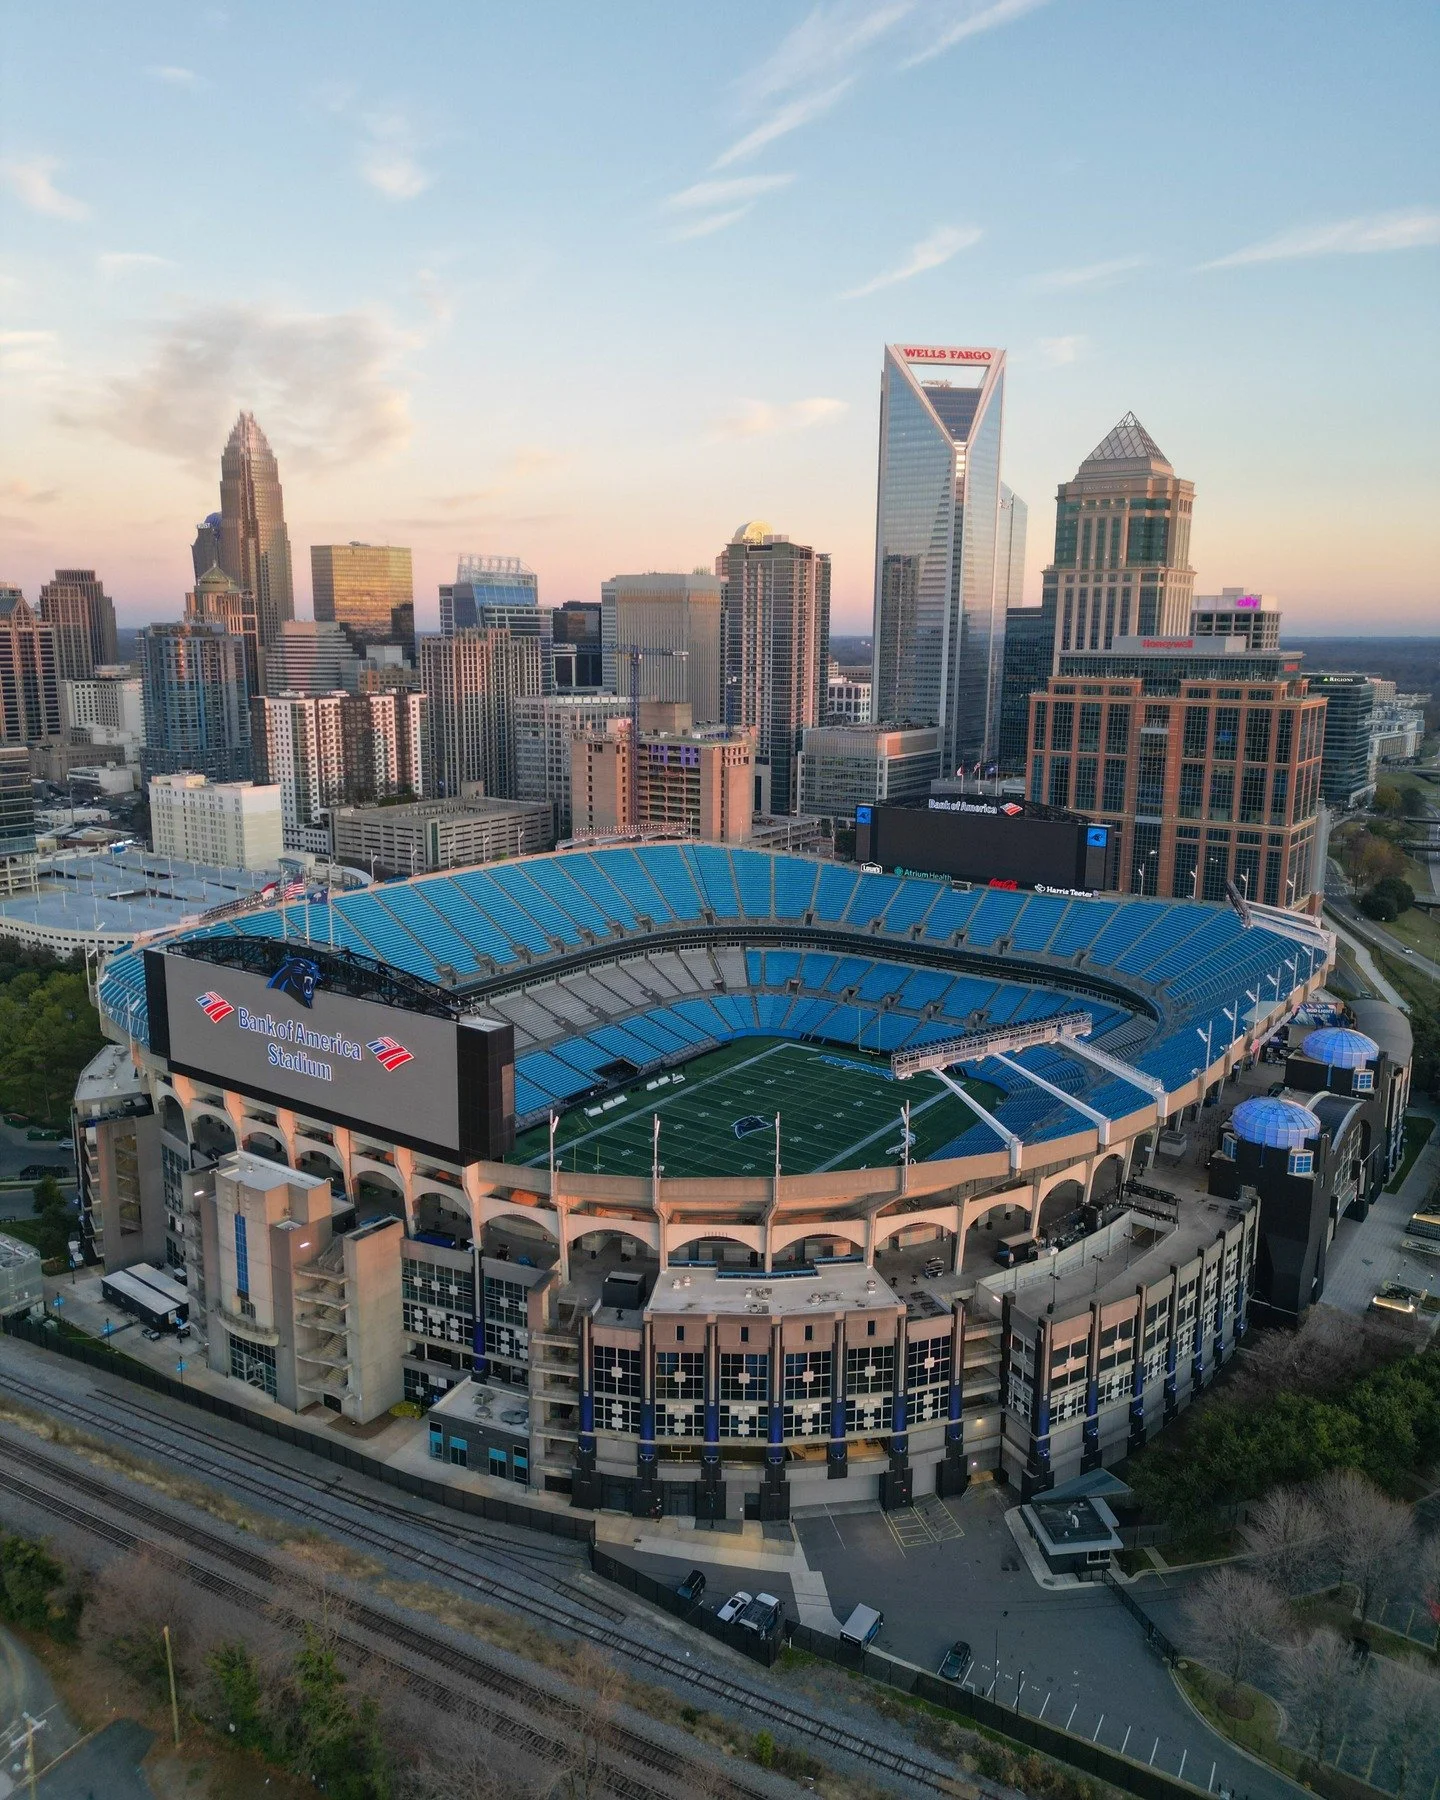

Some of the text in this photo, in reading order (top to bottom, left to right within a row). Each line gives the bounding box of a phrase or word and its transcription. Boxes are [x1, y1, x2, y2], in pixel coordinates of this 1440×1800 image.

[903, 348, 992, 360] WELLS FARGO
[1236, 596, 1260, 608] ally
[1142, 640, 1194, 649] Honeywell
[928, 798, 998, 814] Bank of America
[904, 869, 952, 882] Atrium Health
[1046, 886, 1093, 898] Harris Teeter
[238, 1006, 362, 1061] Bank of America
[268, 1042, 332, 1082] Stadium
